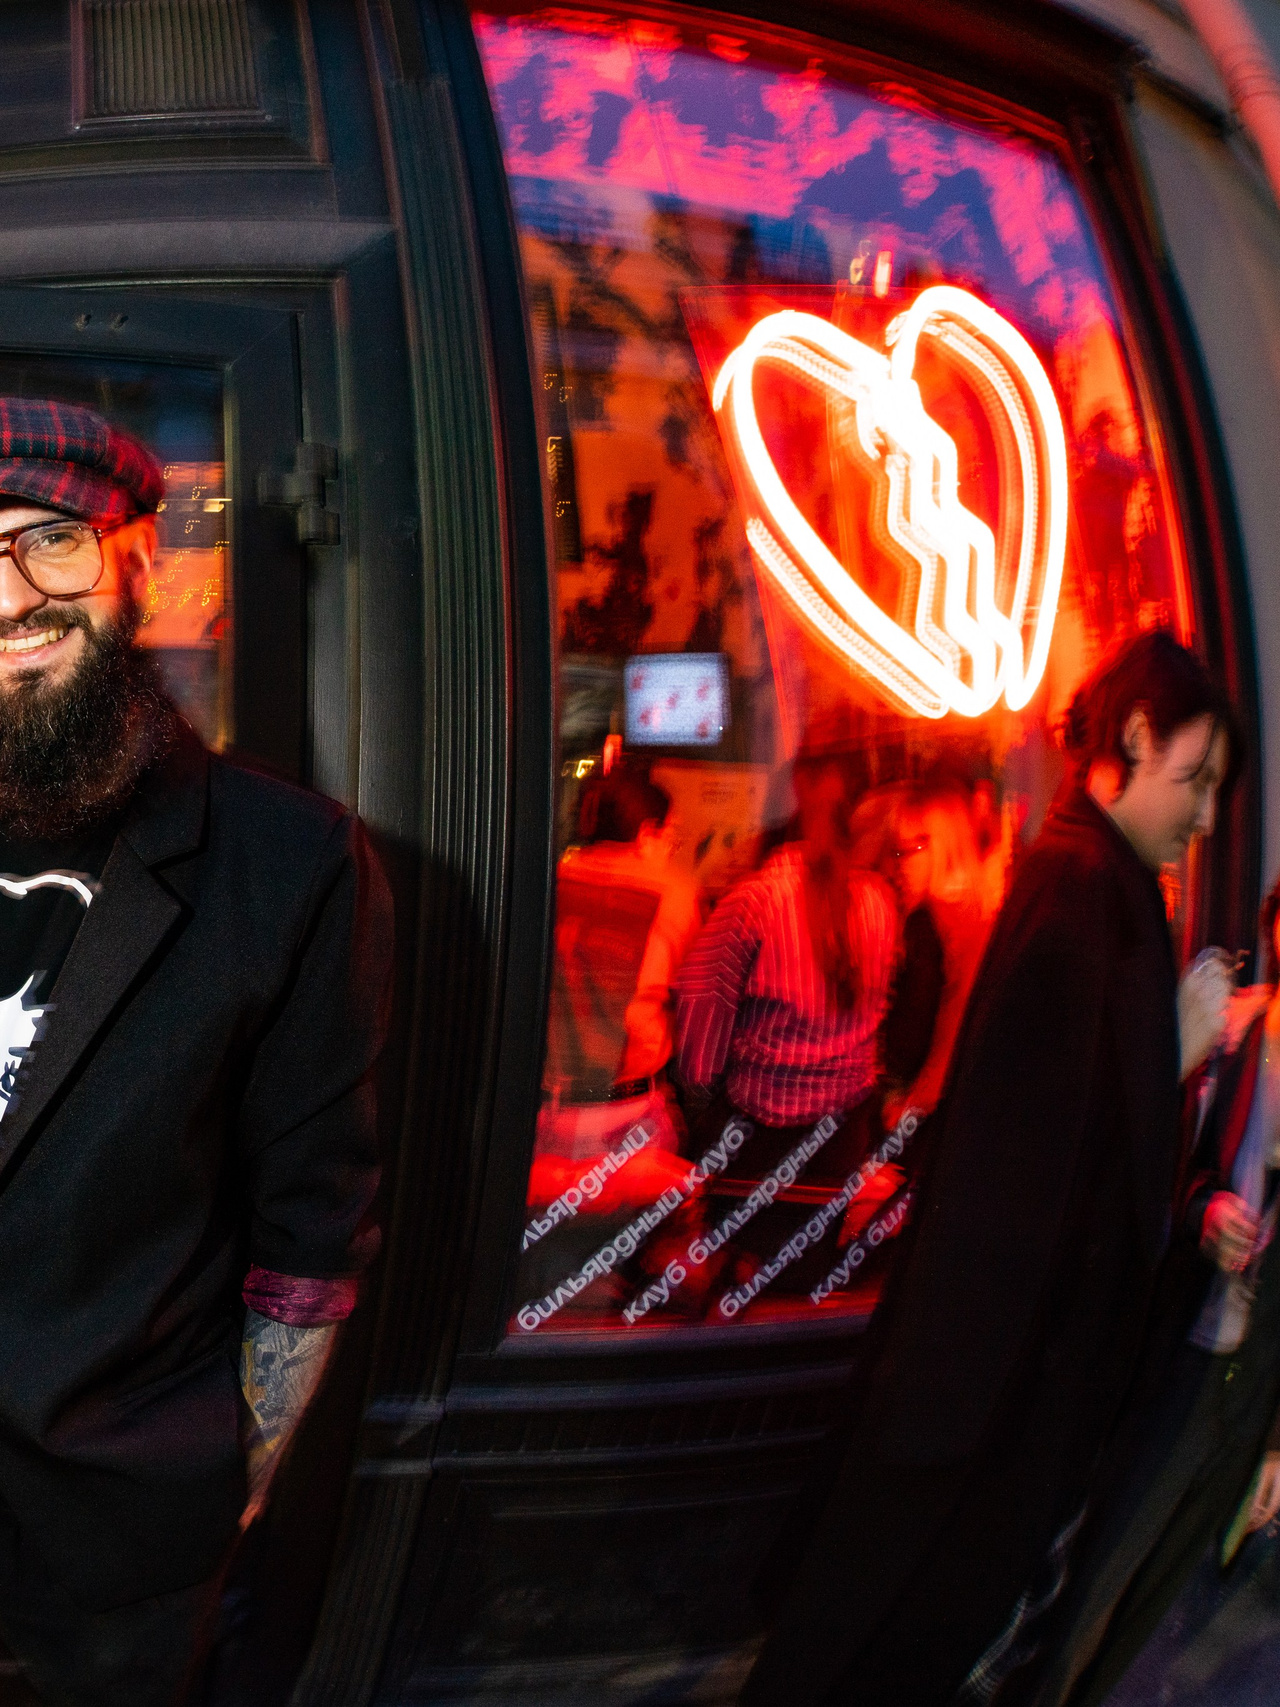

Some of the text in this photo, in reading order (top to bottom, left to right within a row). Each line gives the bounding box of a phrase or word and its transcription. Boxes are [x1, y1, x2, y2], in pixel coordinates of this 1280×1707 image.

[516, 1121, 745, 1331] бильярдный клуб
[622, 1113, 840, 1325] клуб бильярдный
[719, 1108, 918, 1318] бильярдный клуб
[809, 1193, 911, 1306] клуб бил
